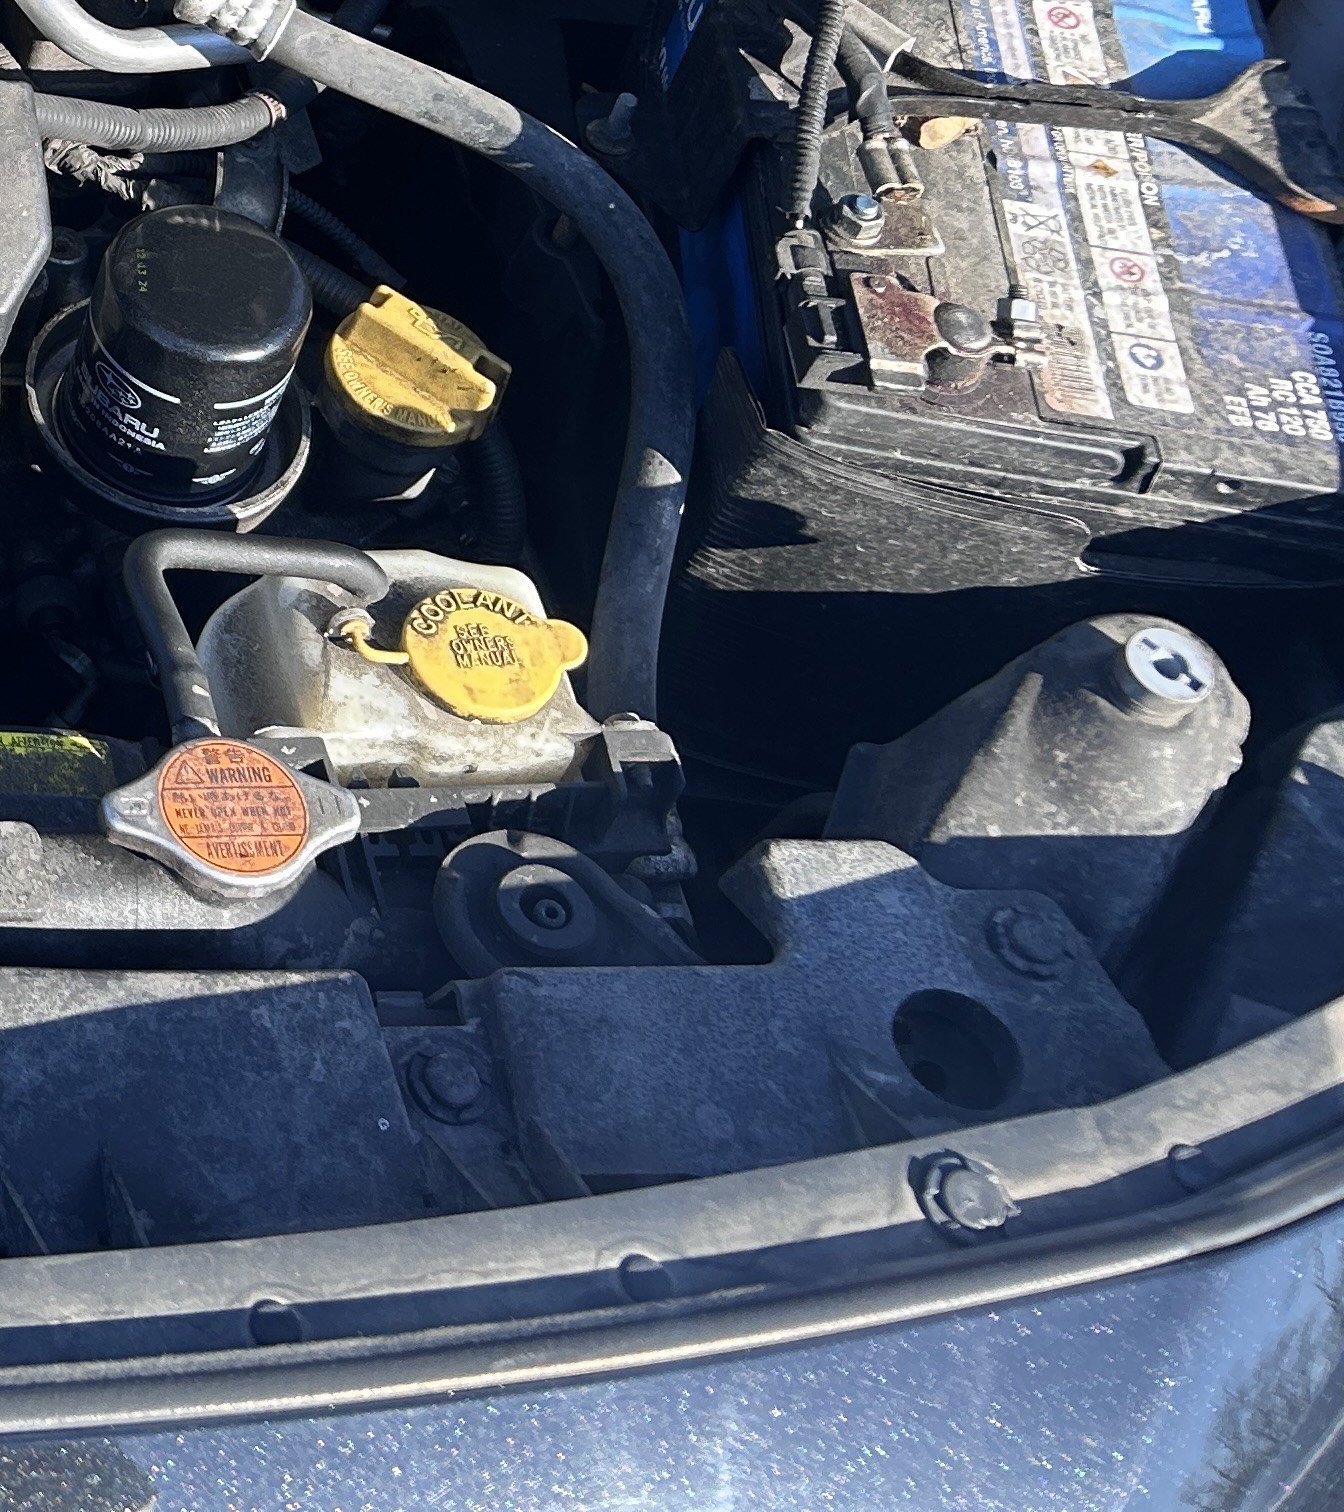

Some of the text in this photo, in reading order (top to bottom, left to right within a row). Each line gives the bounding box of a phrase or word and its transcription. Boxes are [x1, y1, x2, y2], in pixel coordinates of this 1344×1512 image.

[92, 385, 160, 438] UBARU
[1223, 395, 1253, 427] EFB
[1244, 383, 1280, 432] Ah 70
[1276, 407, 1307, 436] 120
[1291, 371, 1333, 441] CCA 750
[453, 623, 490, 639] SEE
[205, 766, 273, 784] WARNING
